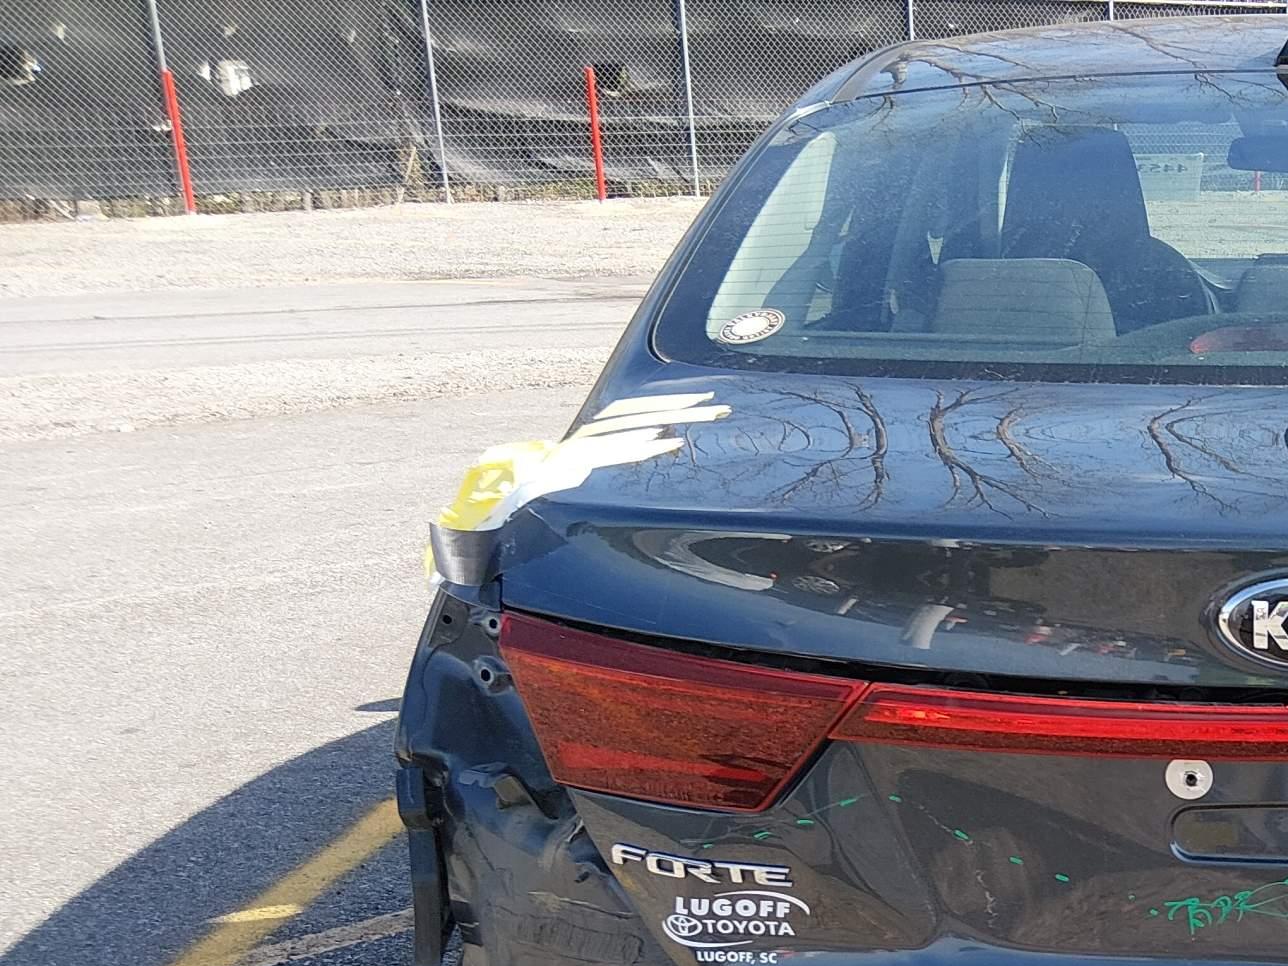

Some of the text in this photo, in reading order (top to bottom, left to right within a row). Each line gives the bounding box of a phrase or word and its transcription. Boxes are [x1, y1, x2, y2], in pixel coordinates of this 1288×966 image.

[611, 843, 793, 887] FORTE
[675, 896, 791, 918] LUGOFF
[701, 919, 796, 936] TOYOTA
[697, 950, 778, 965] LUGOFF, SC
